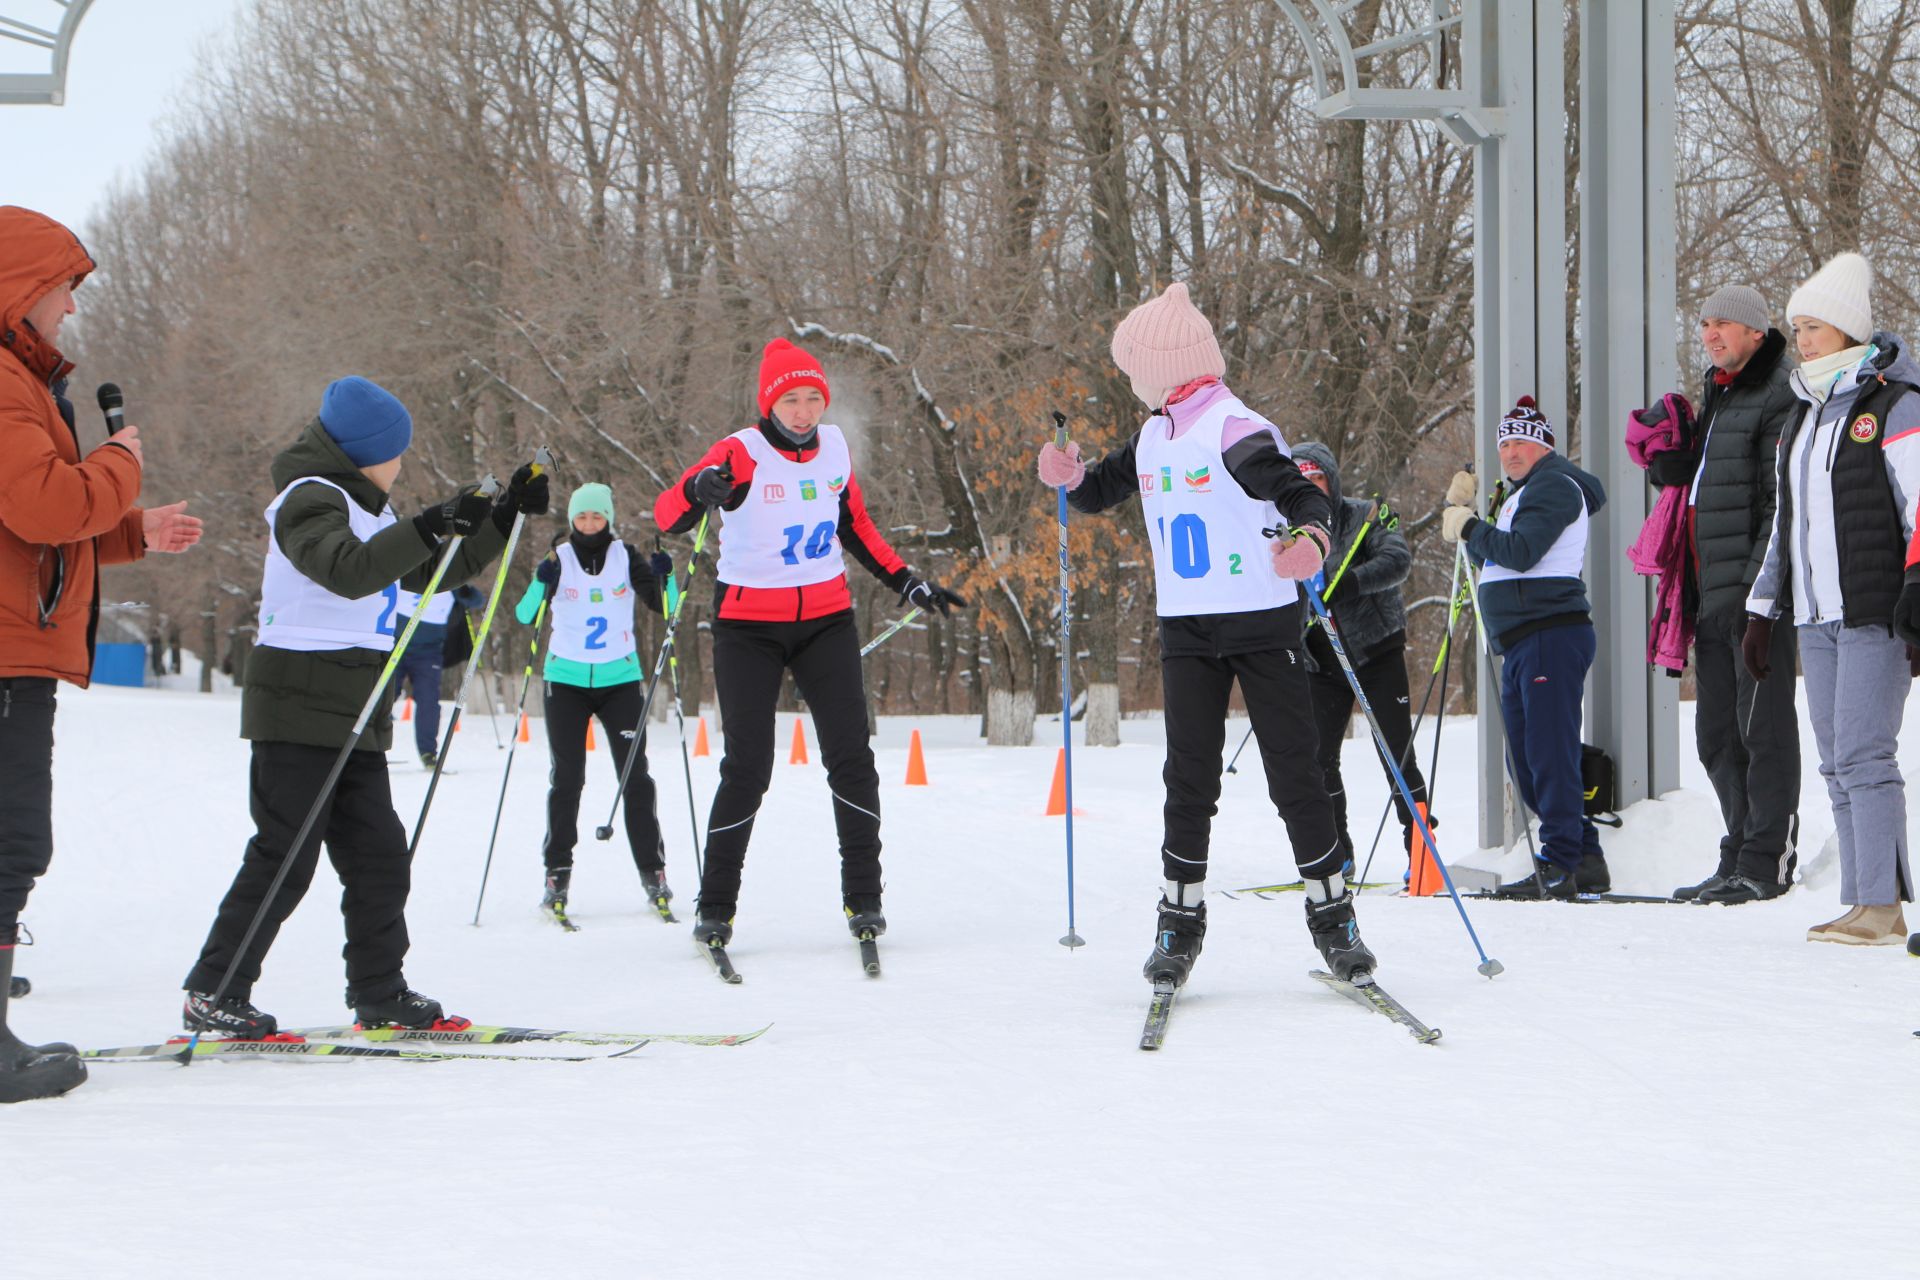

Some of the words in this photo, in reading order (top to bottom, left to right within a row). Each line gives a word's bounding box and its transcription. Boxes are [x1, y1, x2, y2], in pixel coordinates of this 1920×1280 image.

[780, 519, 836, 565] 10
[1228, 553, 1243, 575] 2
[584, 616, 608, 650] 2
